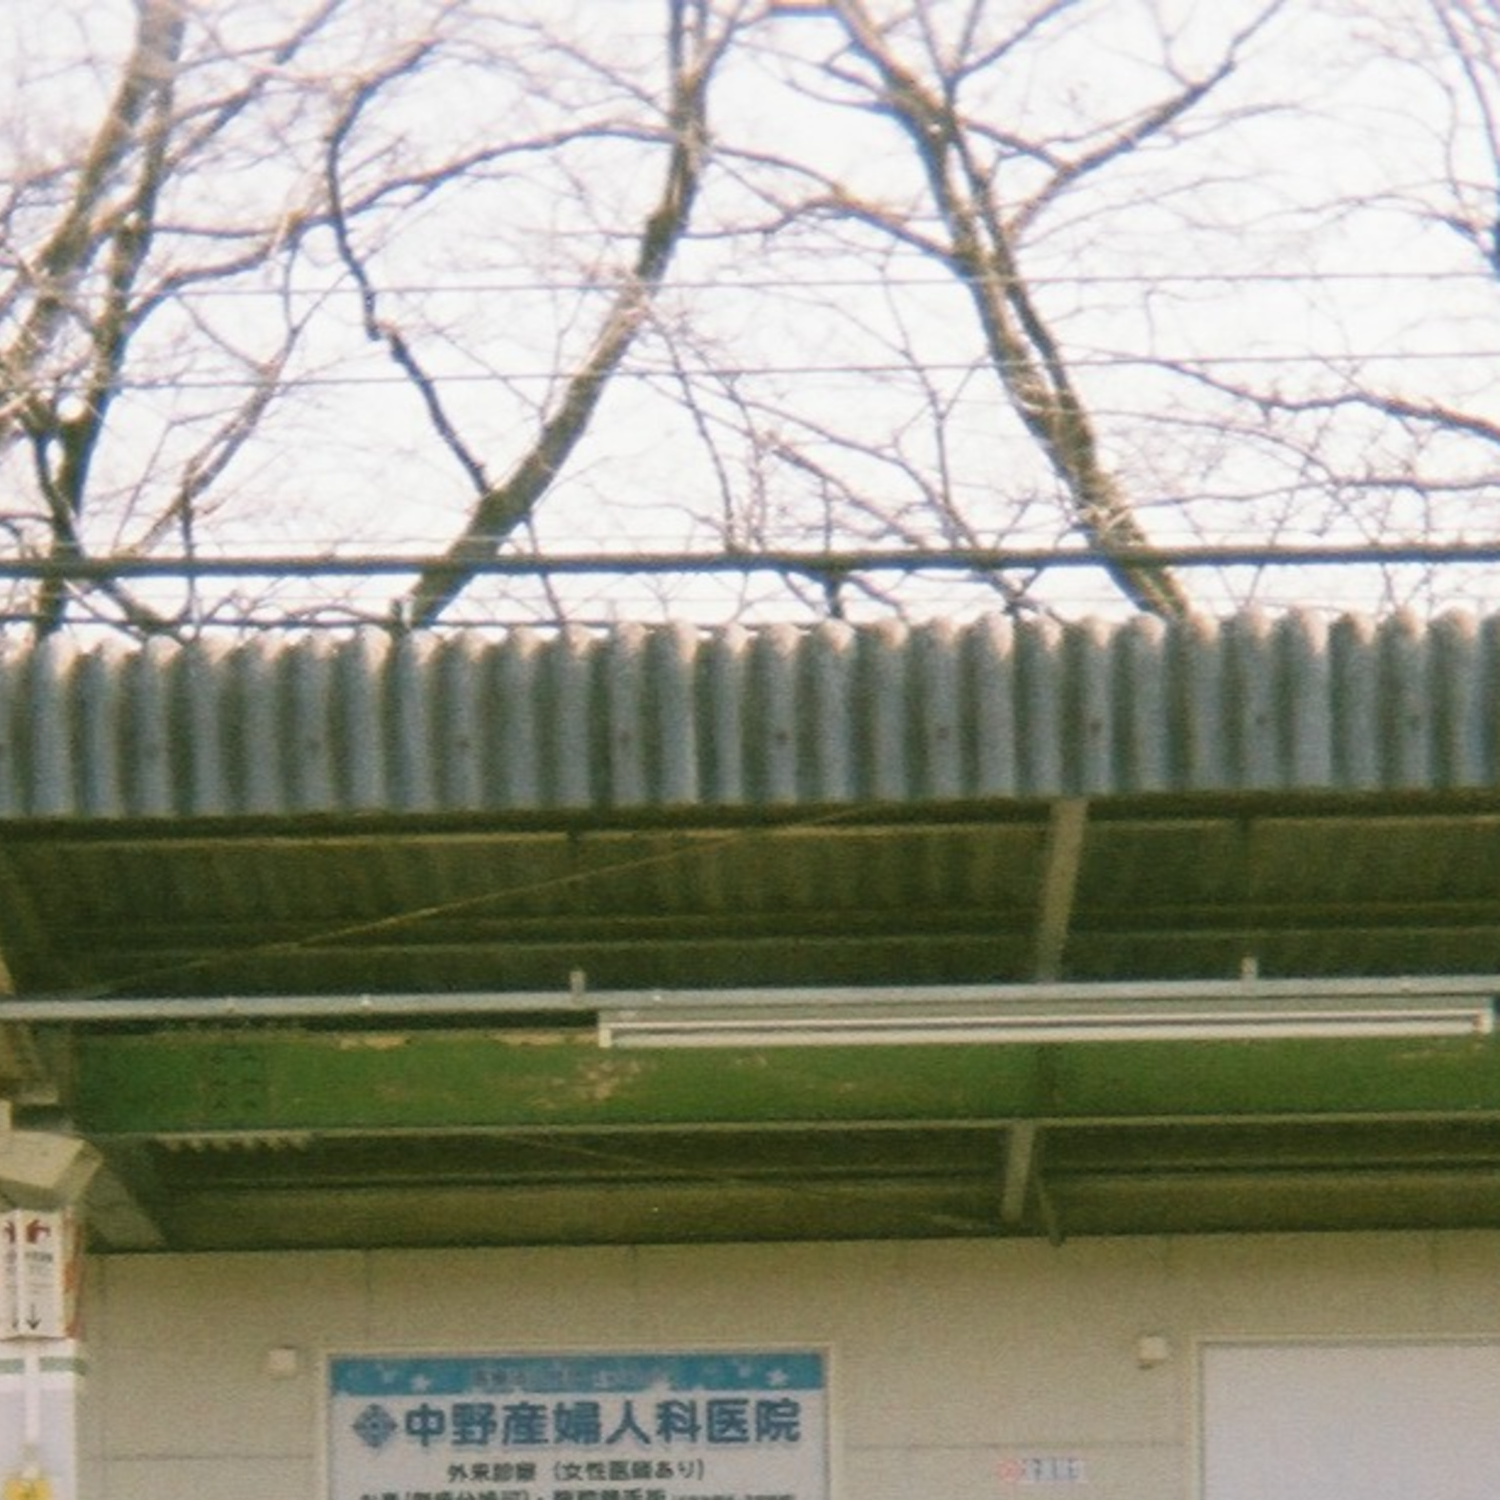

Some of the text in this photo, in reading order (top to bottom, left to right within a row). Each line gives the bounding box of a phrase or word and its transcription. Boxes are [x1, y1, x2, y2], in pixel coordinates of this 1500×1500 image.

[404, 1397, 802, 1447] 中野産婦人科医院
